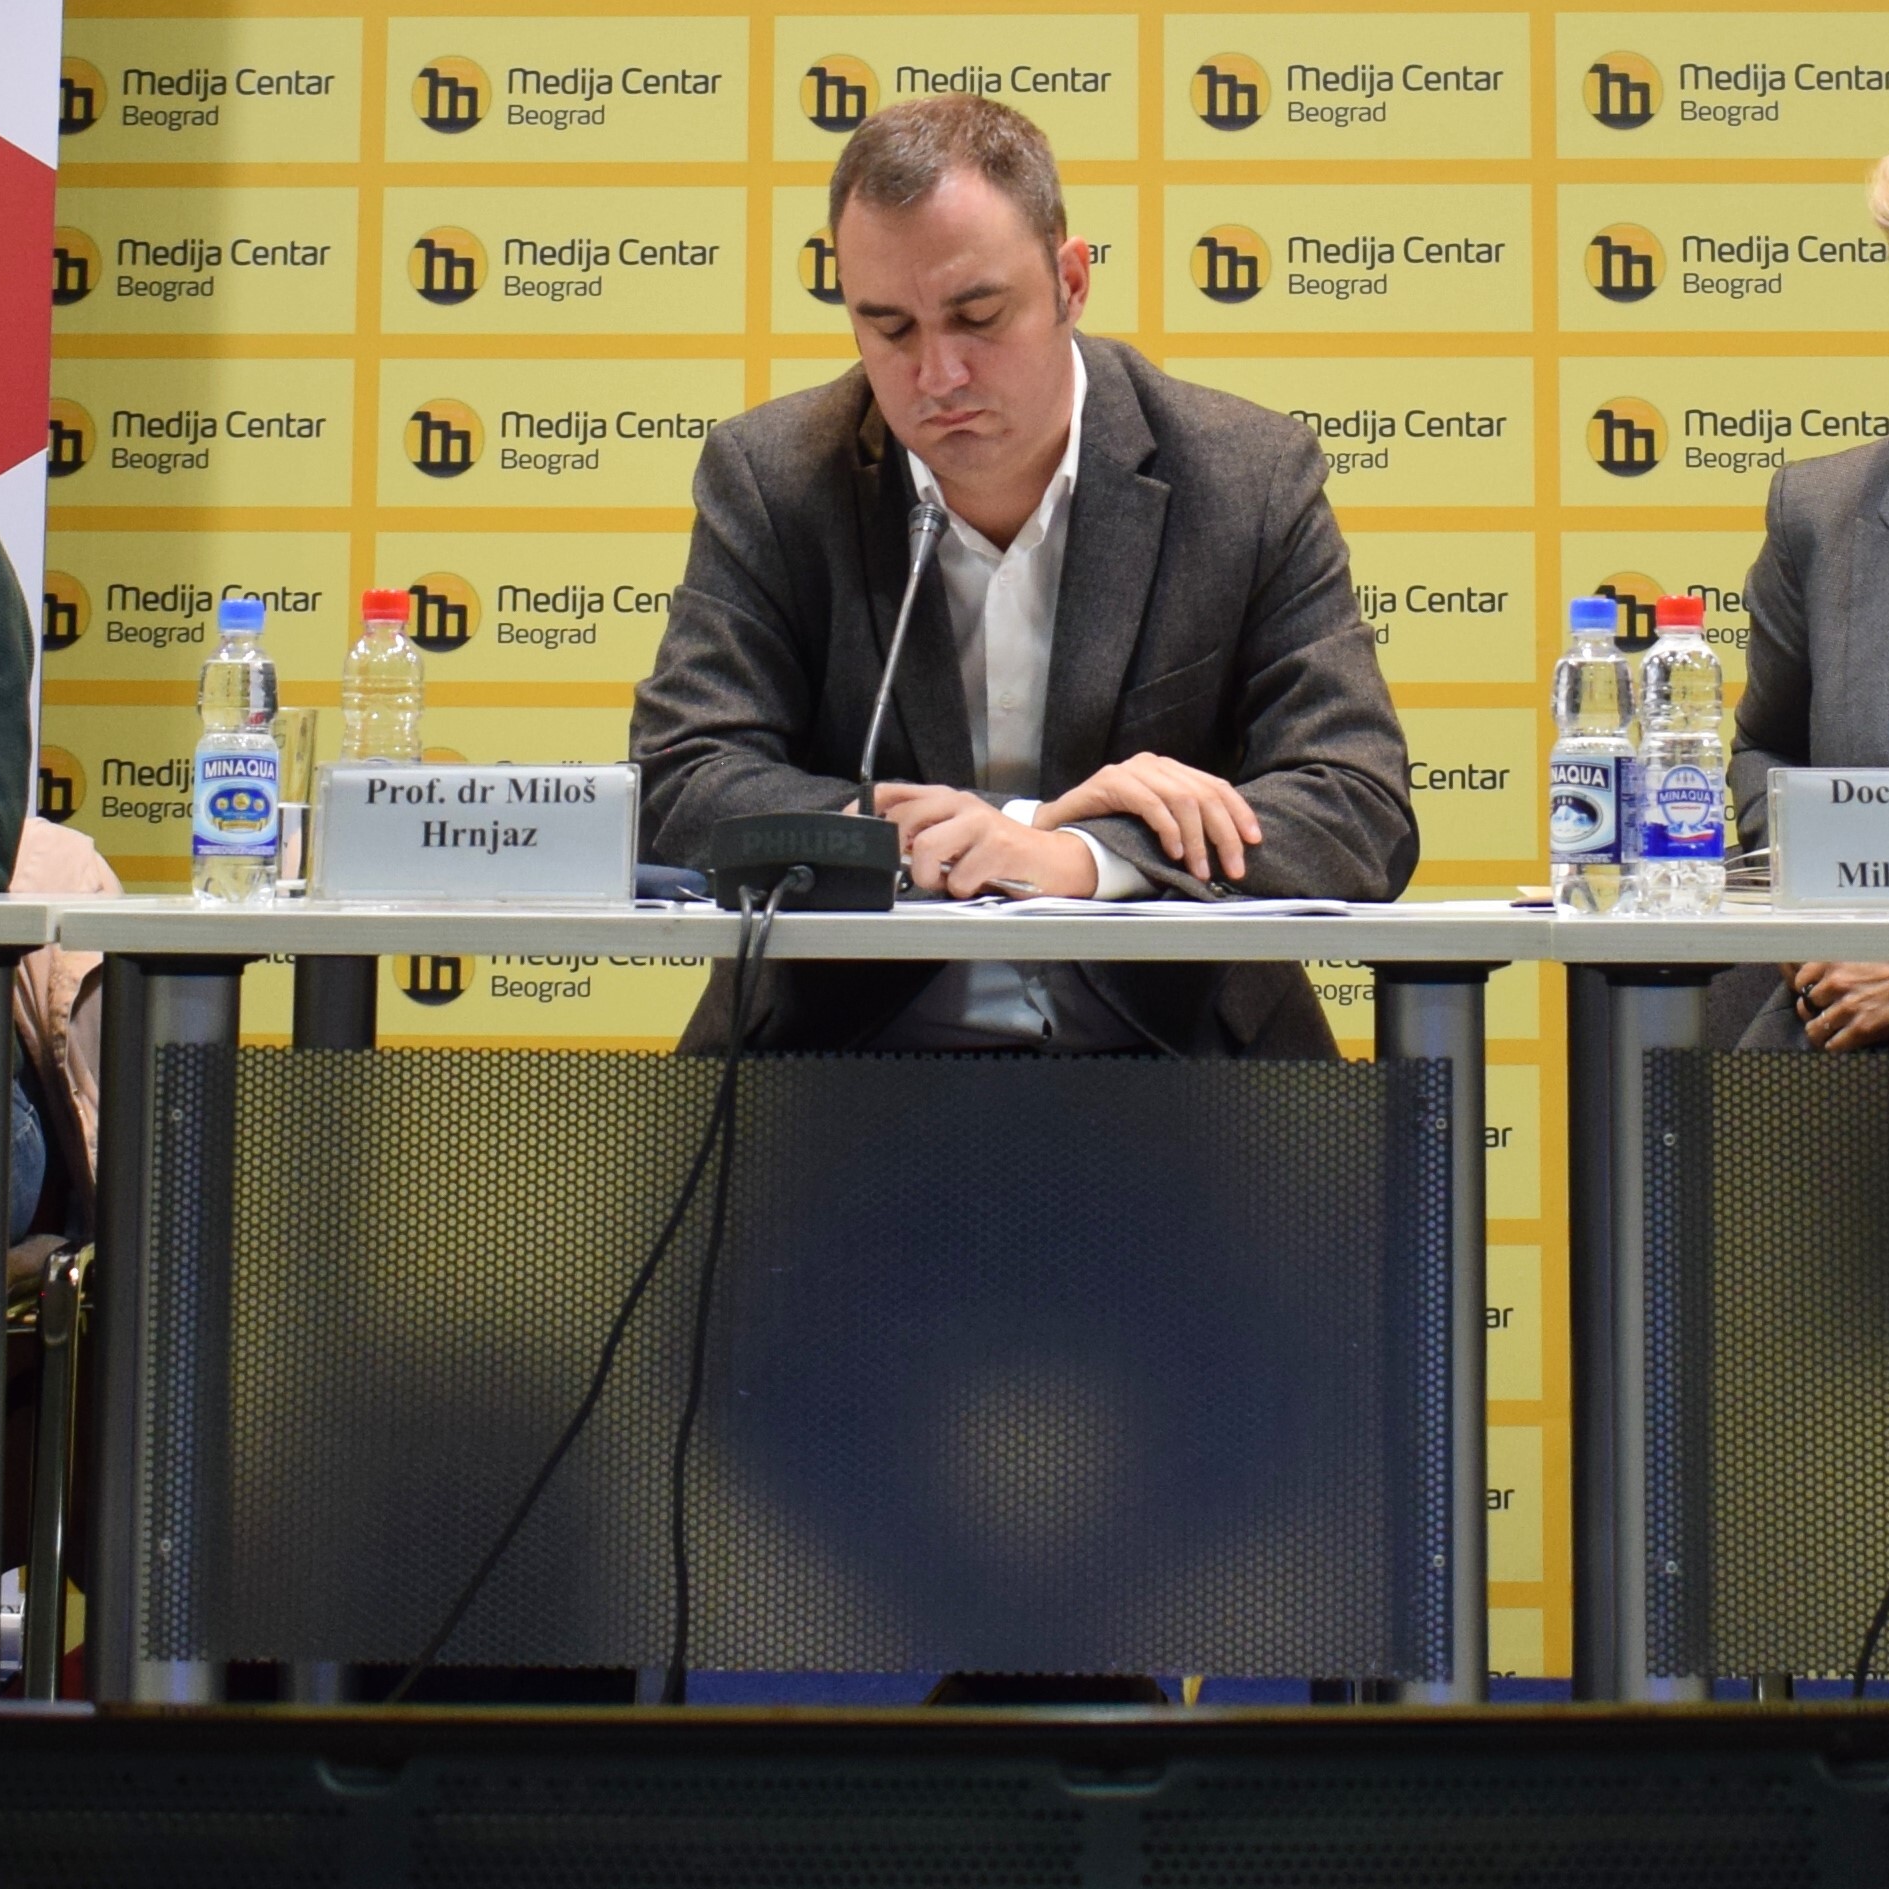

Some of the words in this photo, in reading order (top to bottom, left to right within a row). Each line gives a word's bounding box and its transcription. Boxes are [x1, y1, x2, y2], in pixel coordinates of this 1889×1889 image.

[204, 759, 276, 780] MINAQUA
[366, 778, 446, 805] Prof.
[457, 778, 495, 805] dr
[507, 778, 596, 804] Miloš
[1659, 790, 1713, 803] MINAQUA
[422, 820, 537, 855] Hrnjaz
